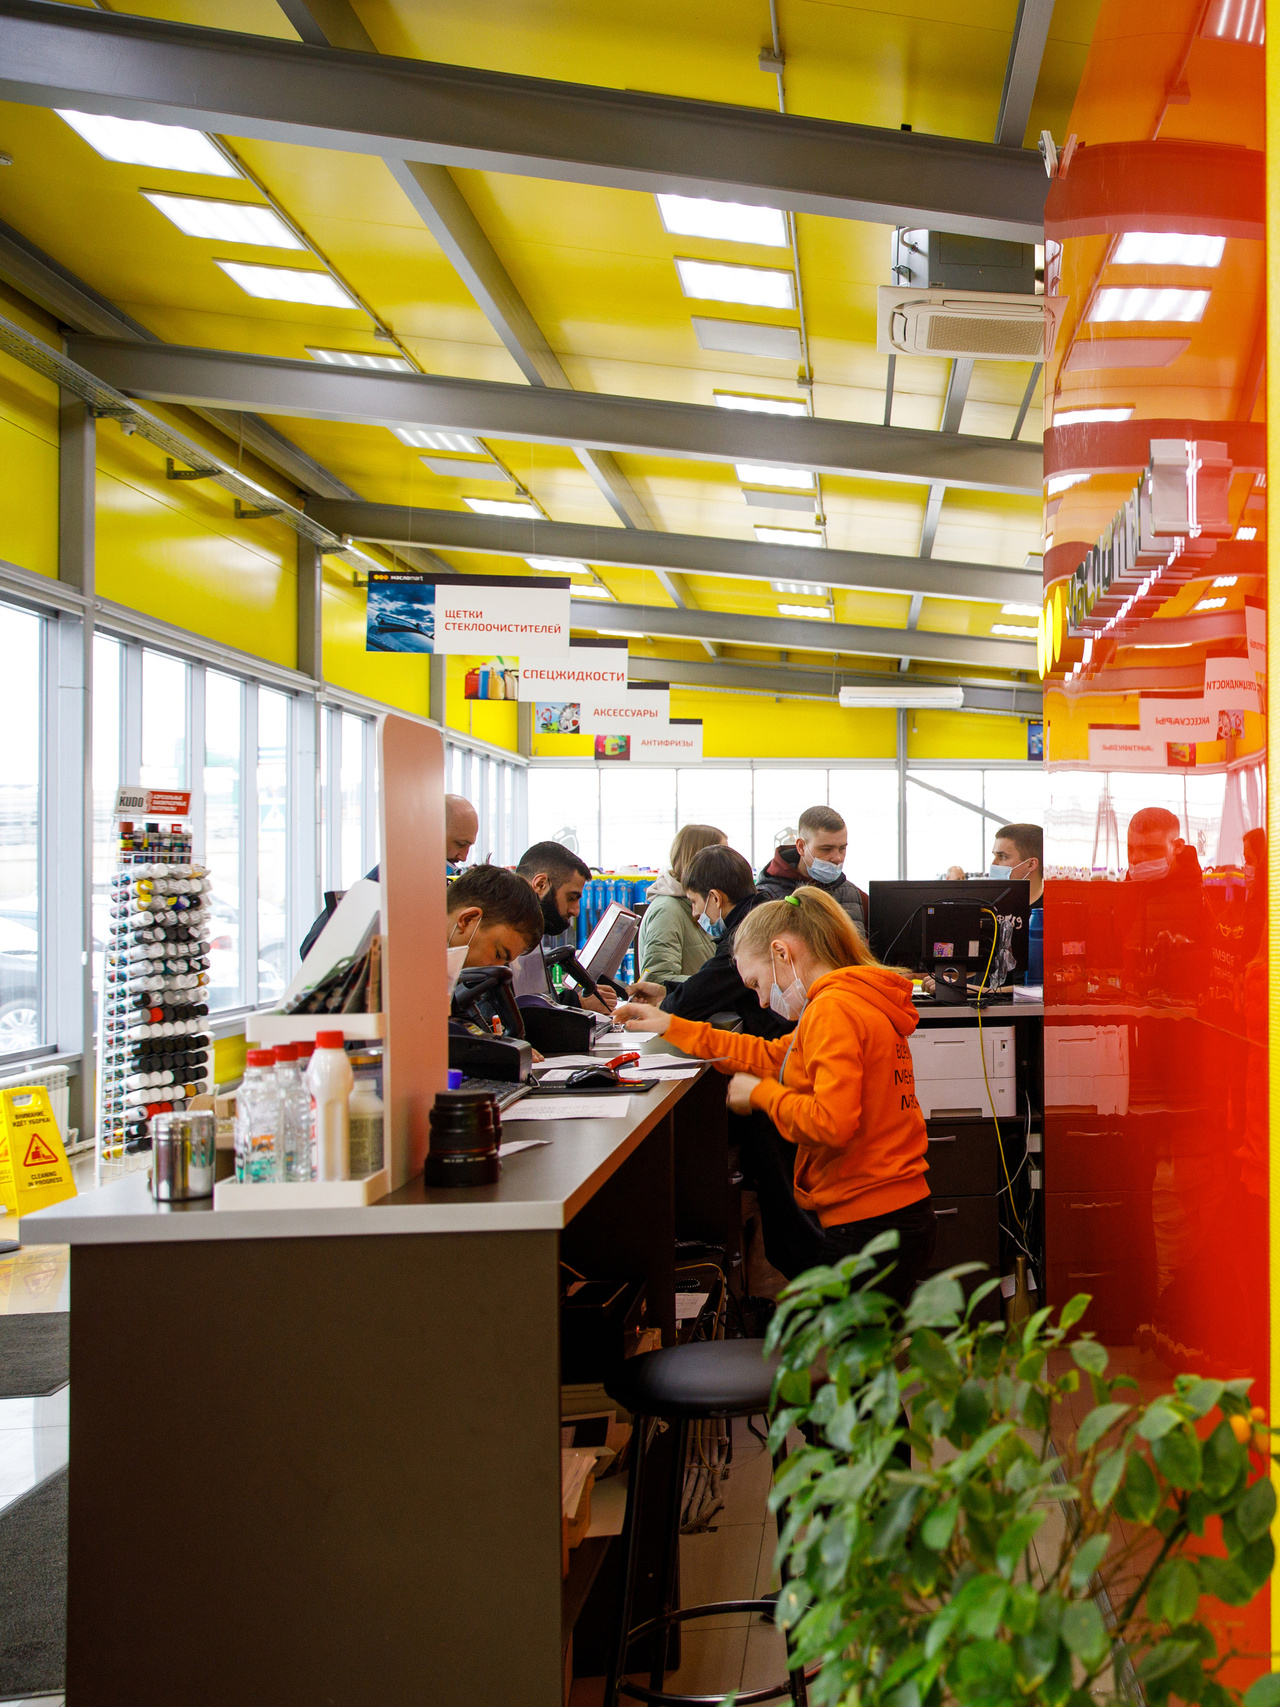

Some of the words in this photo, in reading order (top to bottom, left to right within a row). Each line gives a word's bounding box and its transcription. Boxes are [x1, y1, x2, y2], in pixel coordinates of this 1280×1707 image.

[445, 609, 483, 619] ЩЕТКИ
[444, 622, 561, 634] СТЕКЛООЧИСТИТЕЛЕЙ
[523, 669, 625, 682] СПЕЦЖИДКОСТИ
[593, 708, 658, 718] АКСЕССУАРЫ
[641, 739, 693, 747] АНТИФРИЗЫ
[119, 796, 144, 807] KUDO
[31, 1171, 57, 1180] CLEANING
[35, 1177, 63, 1185] PROGRESS
